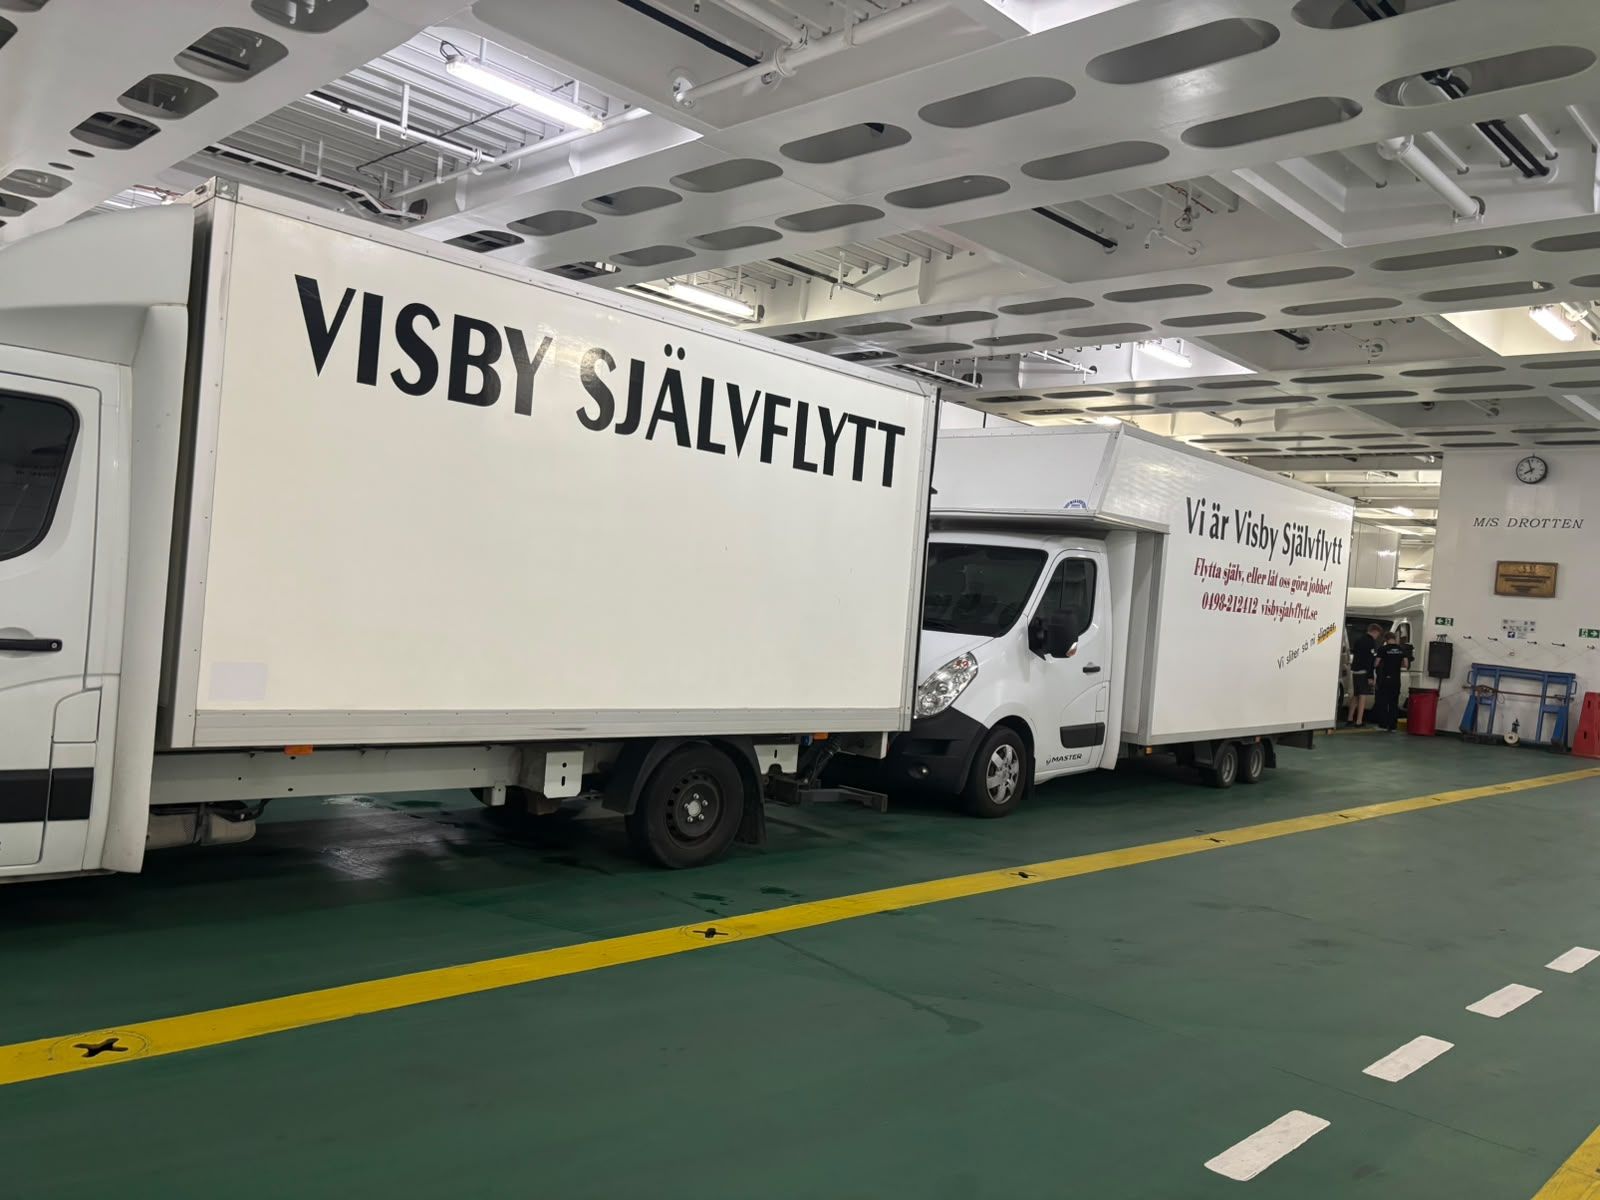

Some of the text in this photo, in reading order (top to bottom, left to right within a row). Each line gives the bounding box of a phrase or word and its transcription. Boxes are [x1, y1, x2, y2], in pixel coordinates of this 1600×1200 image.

[294, 273, 907, 489] VISBY SJÄLVFLYTT
[1186, 496, 1343, 572] Vi är Visby Självflytt
[1473, 517, 1584, 529] M/S DROTTEN
[1193, 557, 1222, 583] Flytta
[1246, 566, 1267, 585] eller
[1267, 569, 1279, 587] låt
[1279, 576, 1291, 588] oss
[1290, 575, 1308, 595] göra
[1307, 577, 1334, 598] jobbet!
[1201, 591, 1260, 615] 0498-212412
[1277, 656, 1285, 669] Vi
[1051, 752, 1083, 763] MASTER
